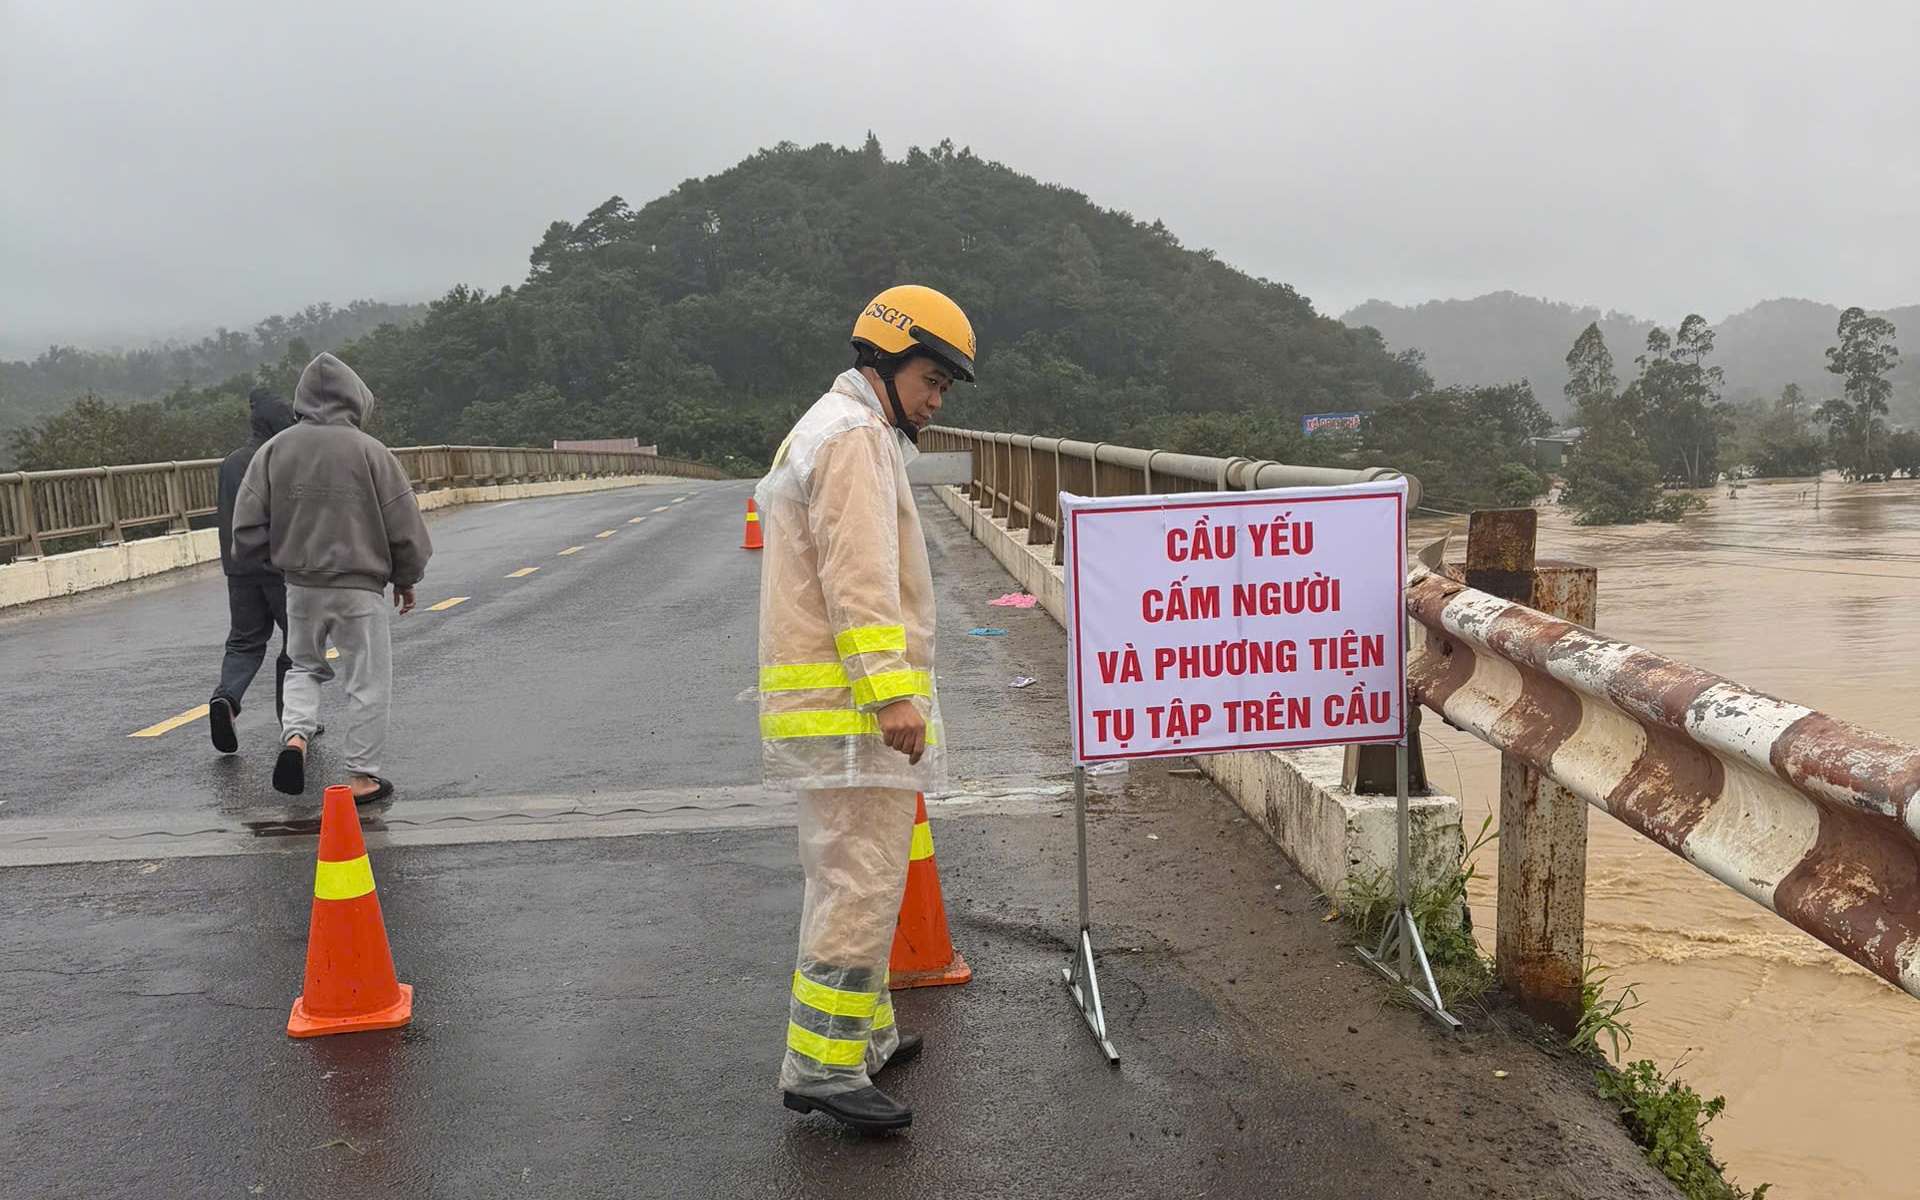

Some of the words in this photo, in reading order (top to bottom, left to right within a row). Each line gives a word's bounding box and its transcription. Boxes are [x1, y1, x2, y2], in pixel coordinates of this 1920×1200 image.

[865, 303, 914, 331] CSGT
[1166, 515, 1235, 562] CẦU
[1248, 511, 1314, 557] YẾU
[1142, 575, 1220, 623] CẤM
[1233, 572, 1341, 616] NGƯỜI
[1098, 643, 1143, 684] VÀ
[1155, 639, 1297, 681] PHƯƠNG
[1309, 629, 1384, 676] TIỆN
[1093, 709, 1134, 748] TỤ
[1146, 698, 1212, 745] TẬP
[1223, 691, 1311, 733] TRÊN
[1323, 681, 1391, 727] CẦU
